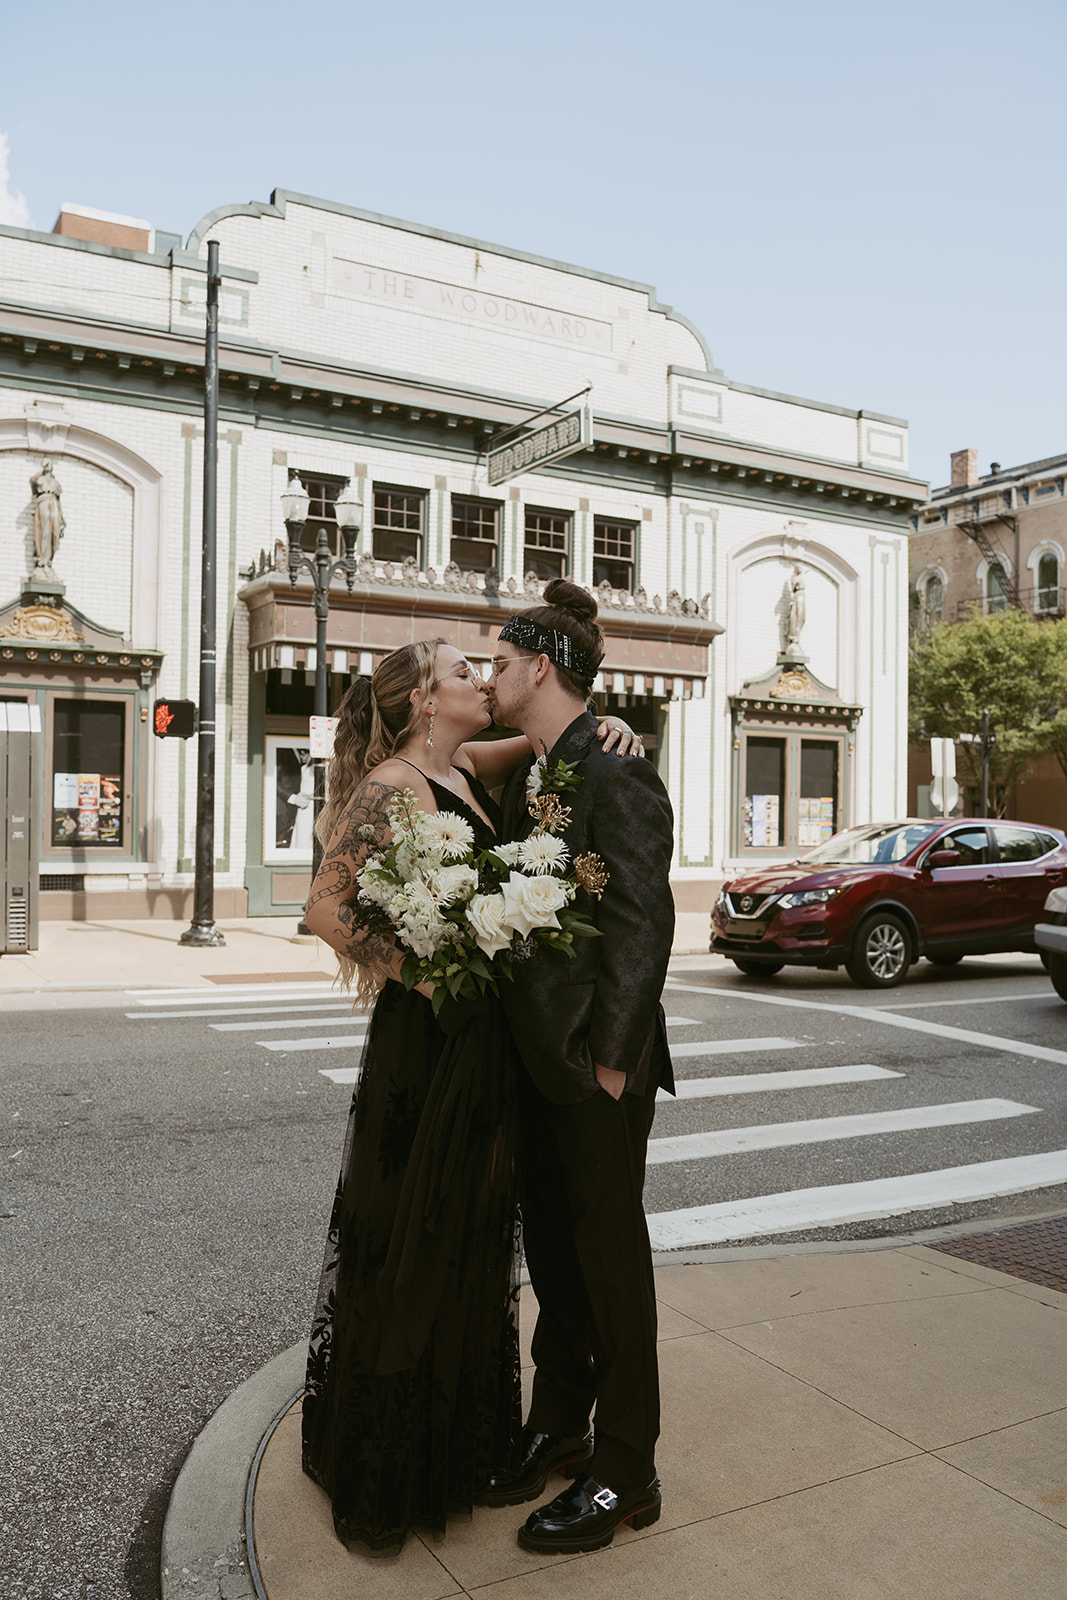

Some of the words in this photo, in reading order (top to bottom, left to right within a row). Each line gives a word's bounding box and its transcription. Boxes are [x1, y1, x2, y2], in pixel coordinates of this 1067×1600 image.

[363, 270, 416, 299] THE
[439, 286, 588, 339] WOODWARD
[489, 416, 579, 480] WOODWARD
